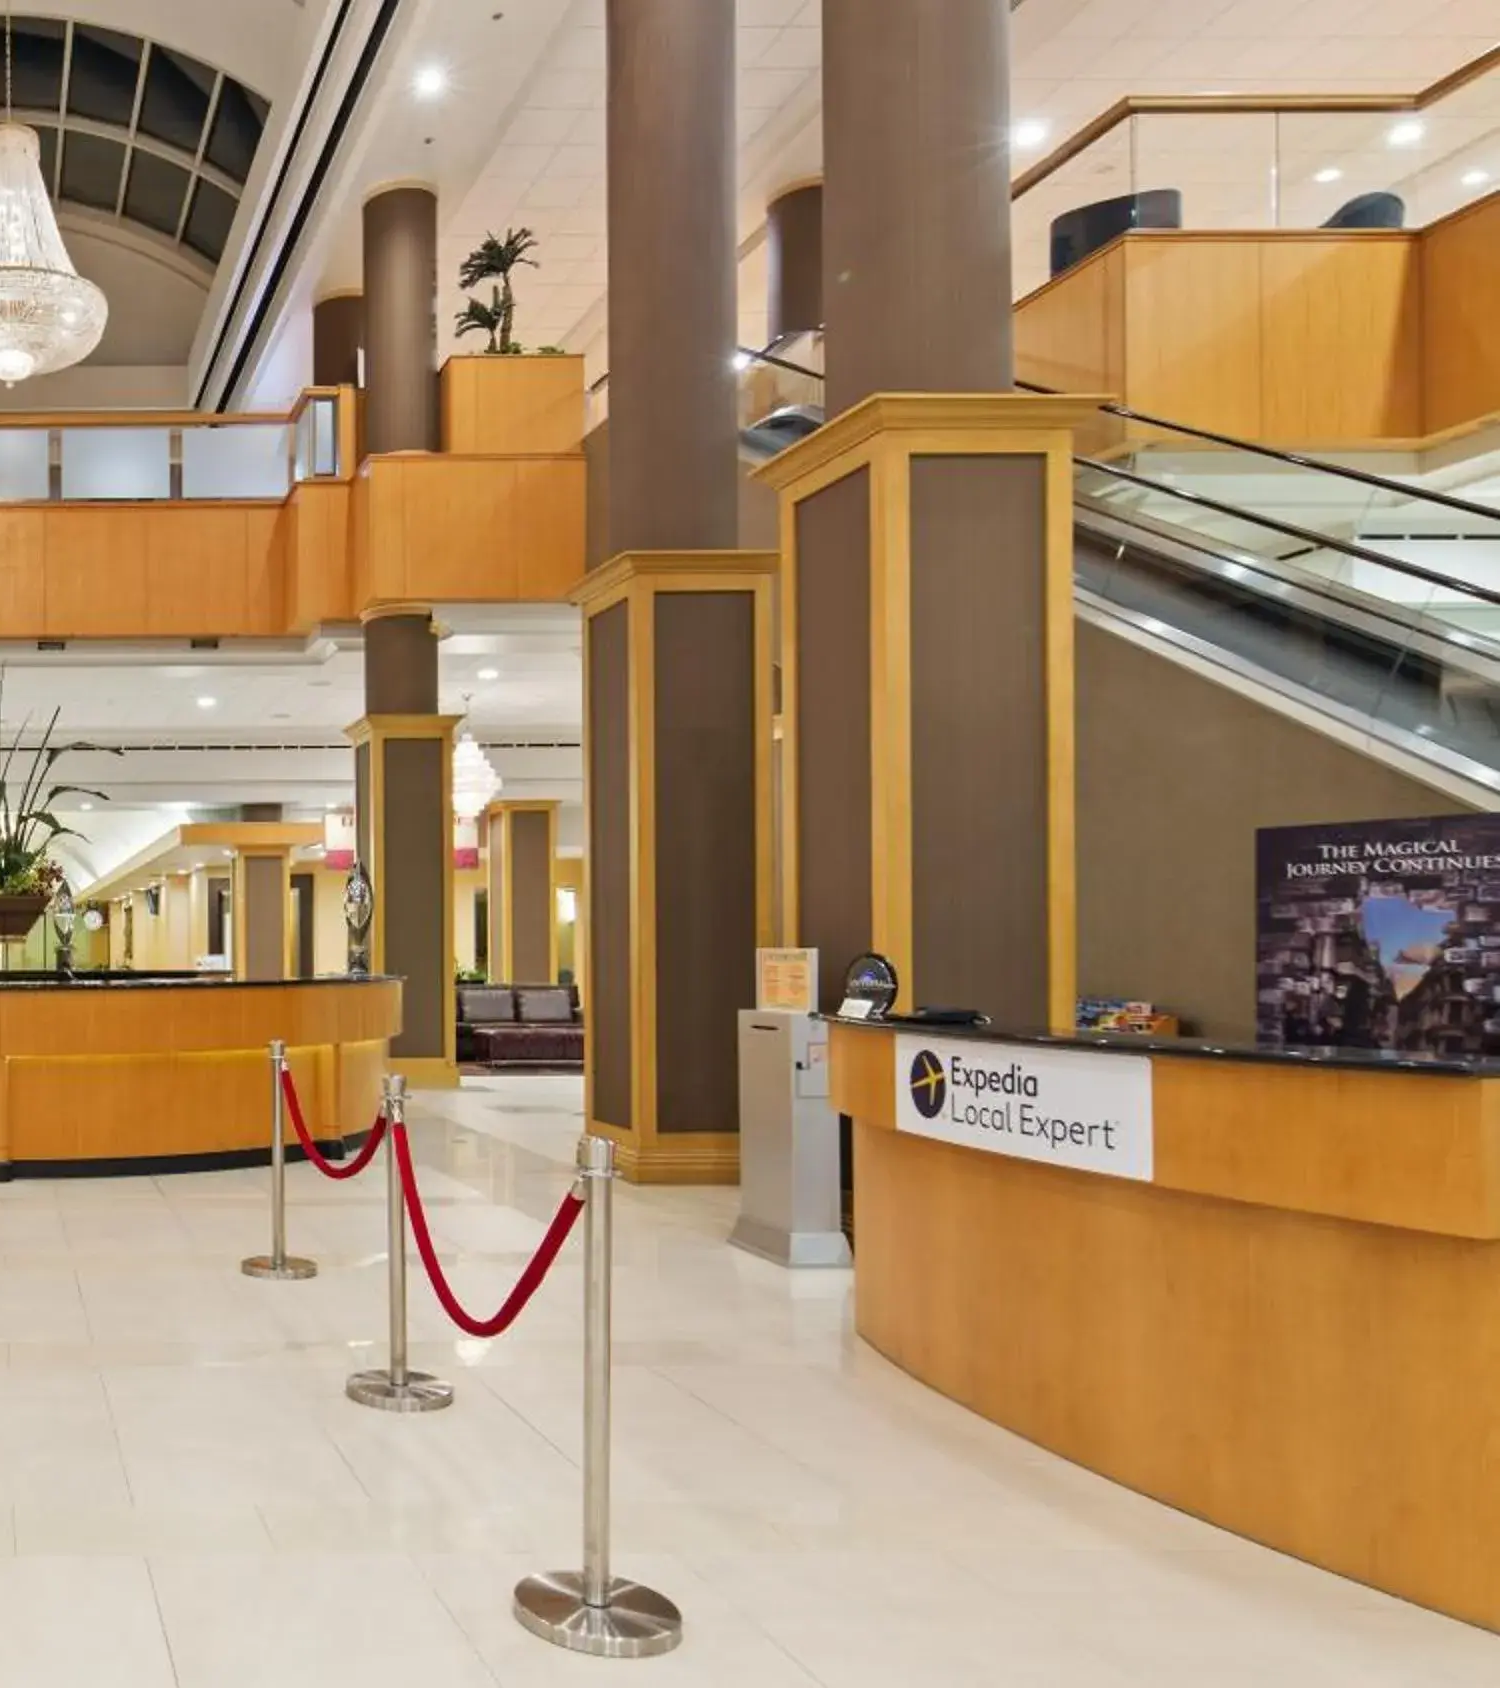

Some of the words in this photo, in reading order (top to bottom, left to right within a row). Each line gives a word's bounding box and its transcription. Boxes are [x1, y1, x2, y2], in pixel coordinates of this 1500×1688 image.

[1317, 845, 1359, 859] THE
[1363, 840, 1463, 857] MAGICAL
[1286, 861, 1369, 880] JOURNEY
[951, 1055, 1038, 1097] Expedia
[951, 1093, 1013, 1133] Local
[1019, 1103, 1116, 1150] Expert
